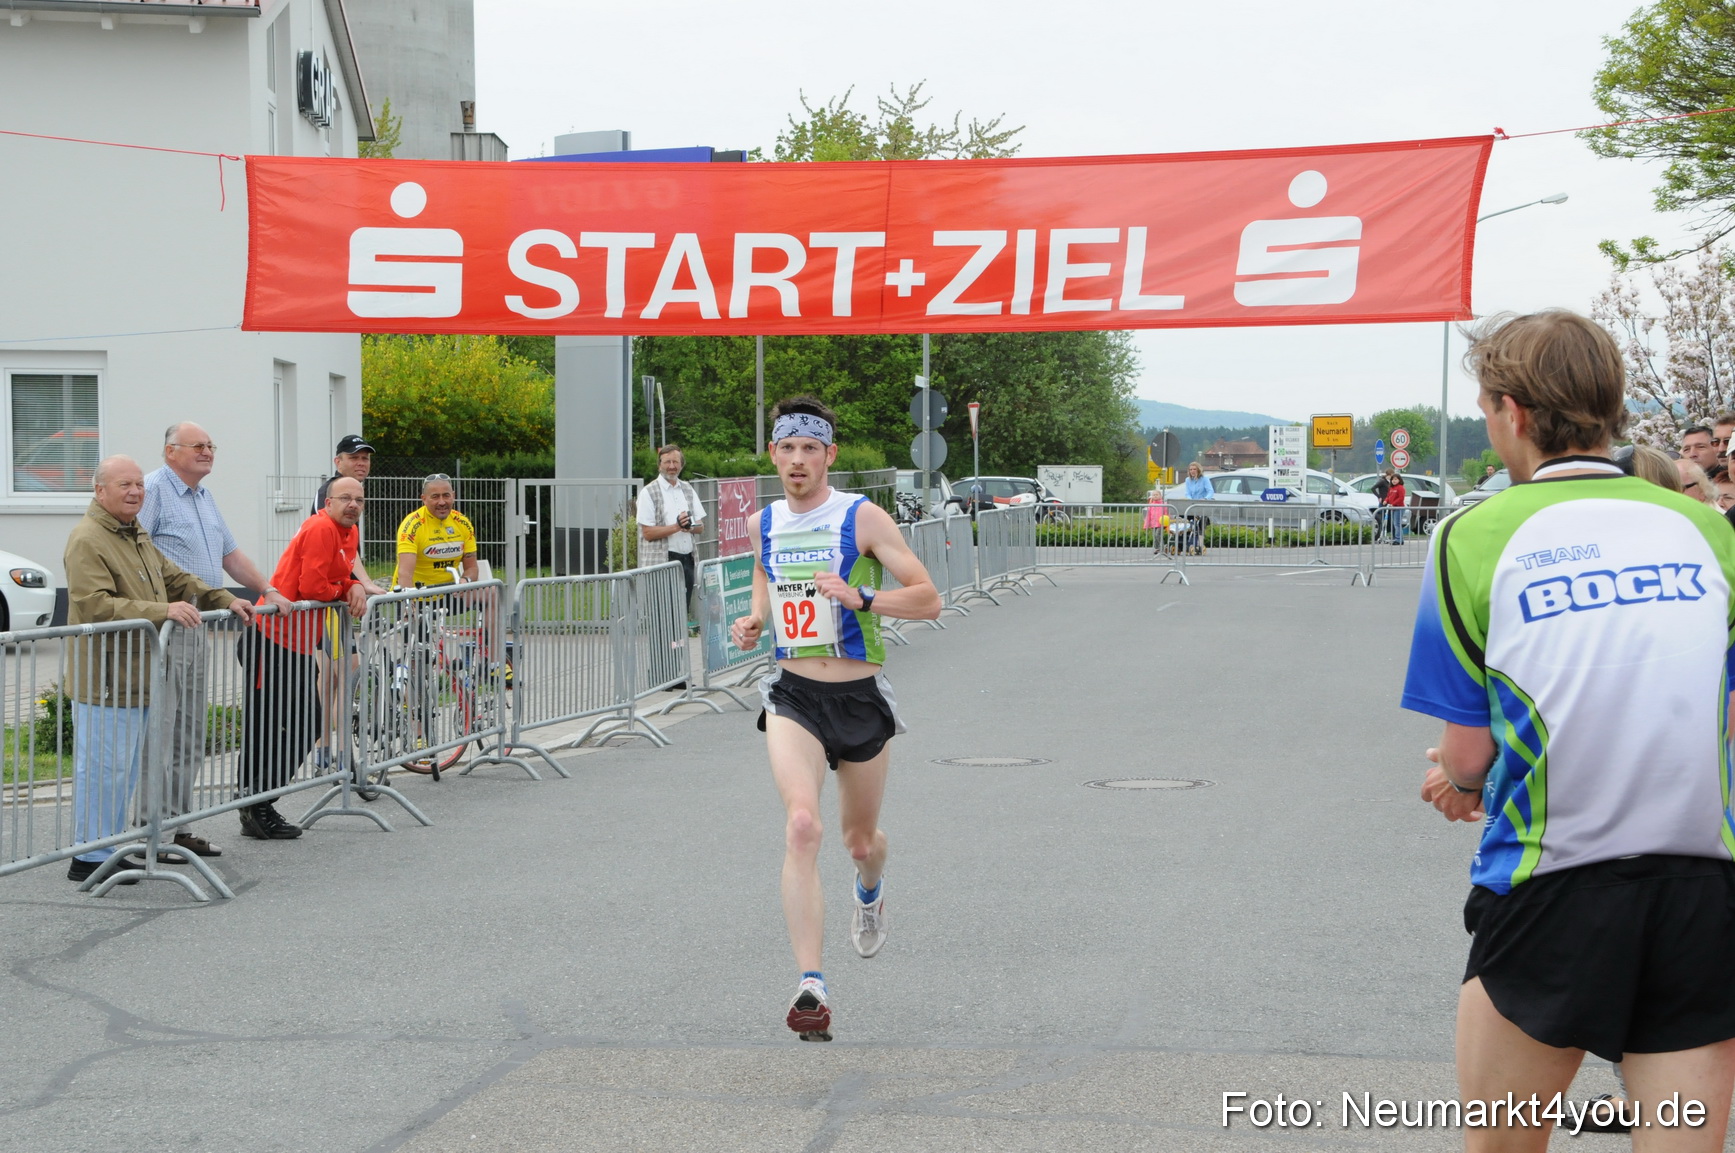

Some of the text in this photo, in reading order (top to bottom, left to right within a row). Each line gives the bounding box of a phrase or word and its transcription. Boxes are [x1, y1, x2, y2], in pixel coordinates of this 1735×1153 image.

[310, 51, 337, 129] GRAF
[1395, 434, 1406, 444] 60
[1265, 493, 1284, 501] VOLVO
[776, 549, 834, 563] BOCK
[1516, 544, 1601, 570] TEAM
[777, 583, 803, 593] MEYER
[1518, 563, 1707, 624] BOCK
[783, 600, 818, 640] 92
